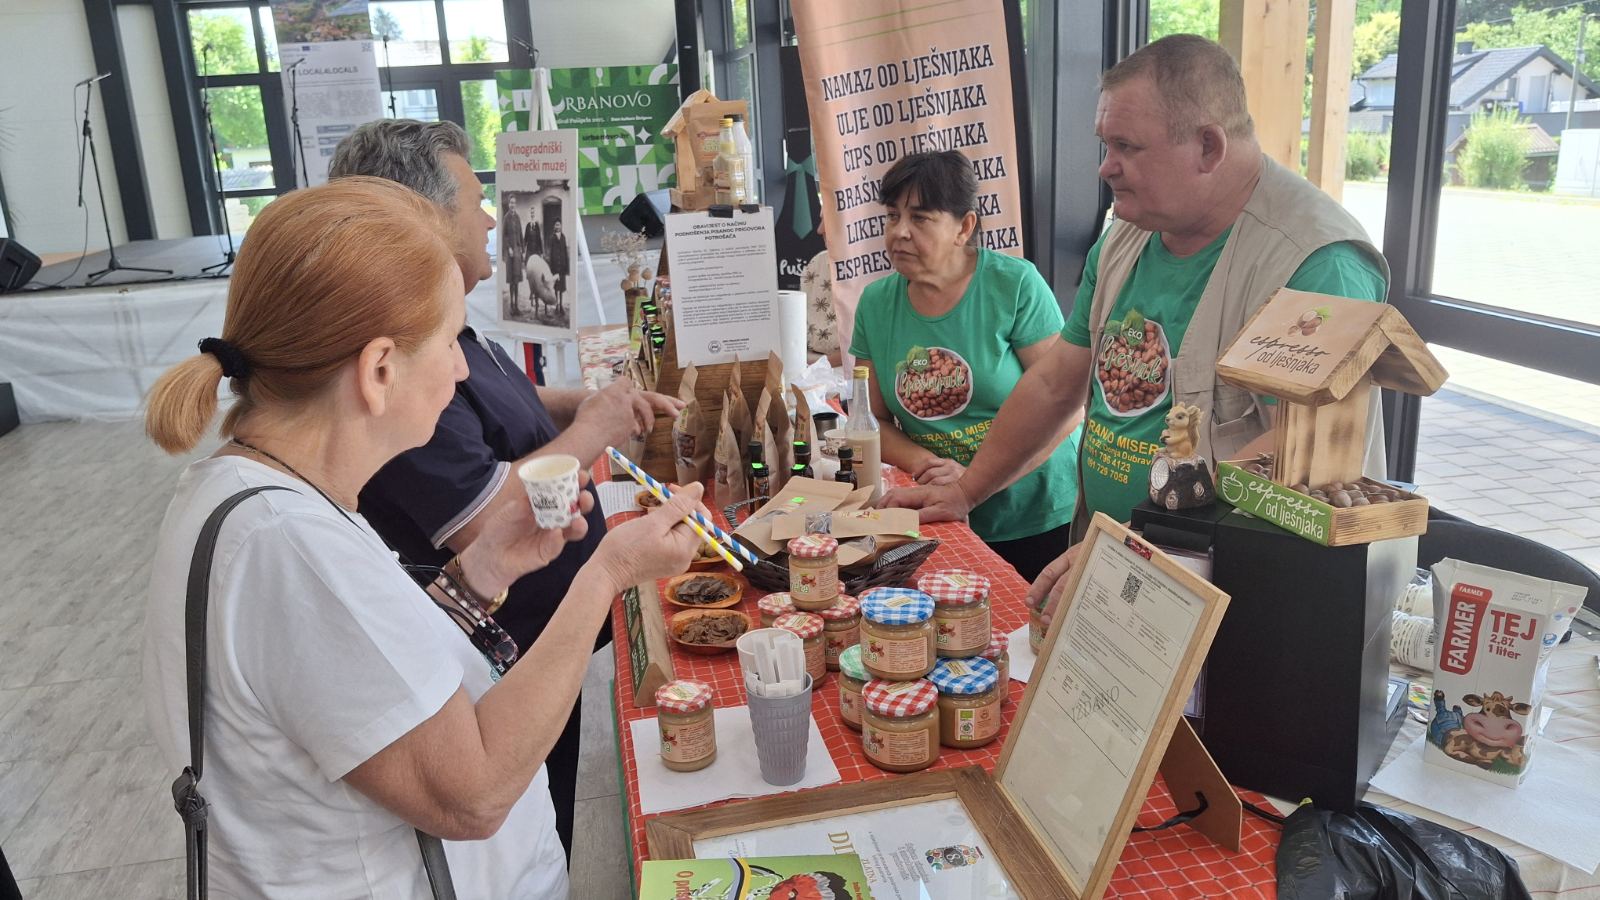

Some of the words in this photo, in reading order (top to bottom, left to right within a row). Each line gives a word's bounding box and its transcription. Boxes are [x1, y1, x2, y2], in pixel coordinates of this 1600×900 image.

[822, 68, 874, 101] NAMAZ
[877, 63, 899, 88] OD
[902, 44, 994, 84] LJEŠNJAKA
[837, 108, 869, 136] ULJE
[873, 103, 894, 127] OD
[897, 84, 988, 123] LJEŠNJAKA
[507, 141, 562, 157] Vinogradniški
[843, 144, 873, 172] ČIPS
[876, 140, 897, 167] OD
[503, 160, 511, 172] in
[512, 159, 540, 172] kmečki
[542, 160, 568, 174] muzej
[835, 175, 881, 211] BRAŠN
[835, 250, 894, 281] ESPRES
[1128, 328, 1143, 340] EKO
[1244, 336, 1331, 360] espresso
[1257, 350, 1277, 363] od
[1271, 353, 1320, 375] lješnjaka
[965, 420, 992, 436] MISE
[1122, 451, 1152, 465] Dubrav
[1248, 481, 1326, 515] espresso
[1265, 502, 1279, 518] od
[1279, 503, 1324, 539] lješnjaka
[1447, 601, 1477, 670] FARMER
[1490, 609, 1537, 641] TEJ
[1488, 644, 1493, 653] 1
[1495, 644, 1522, 660] liter
